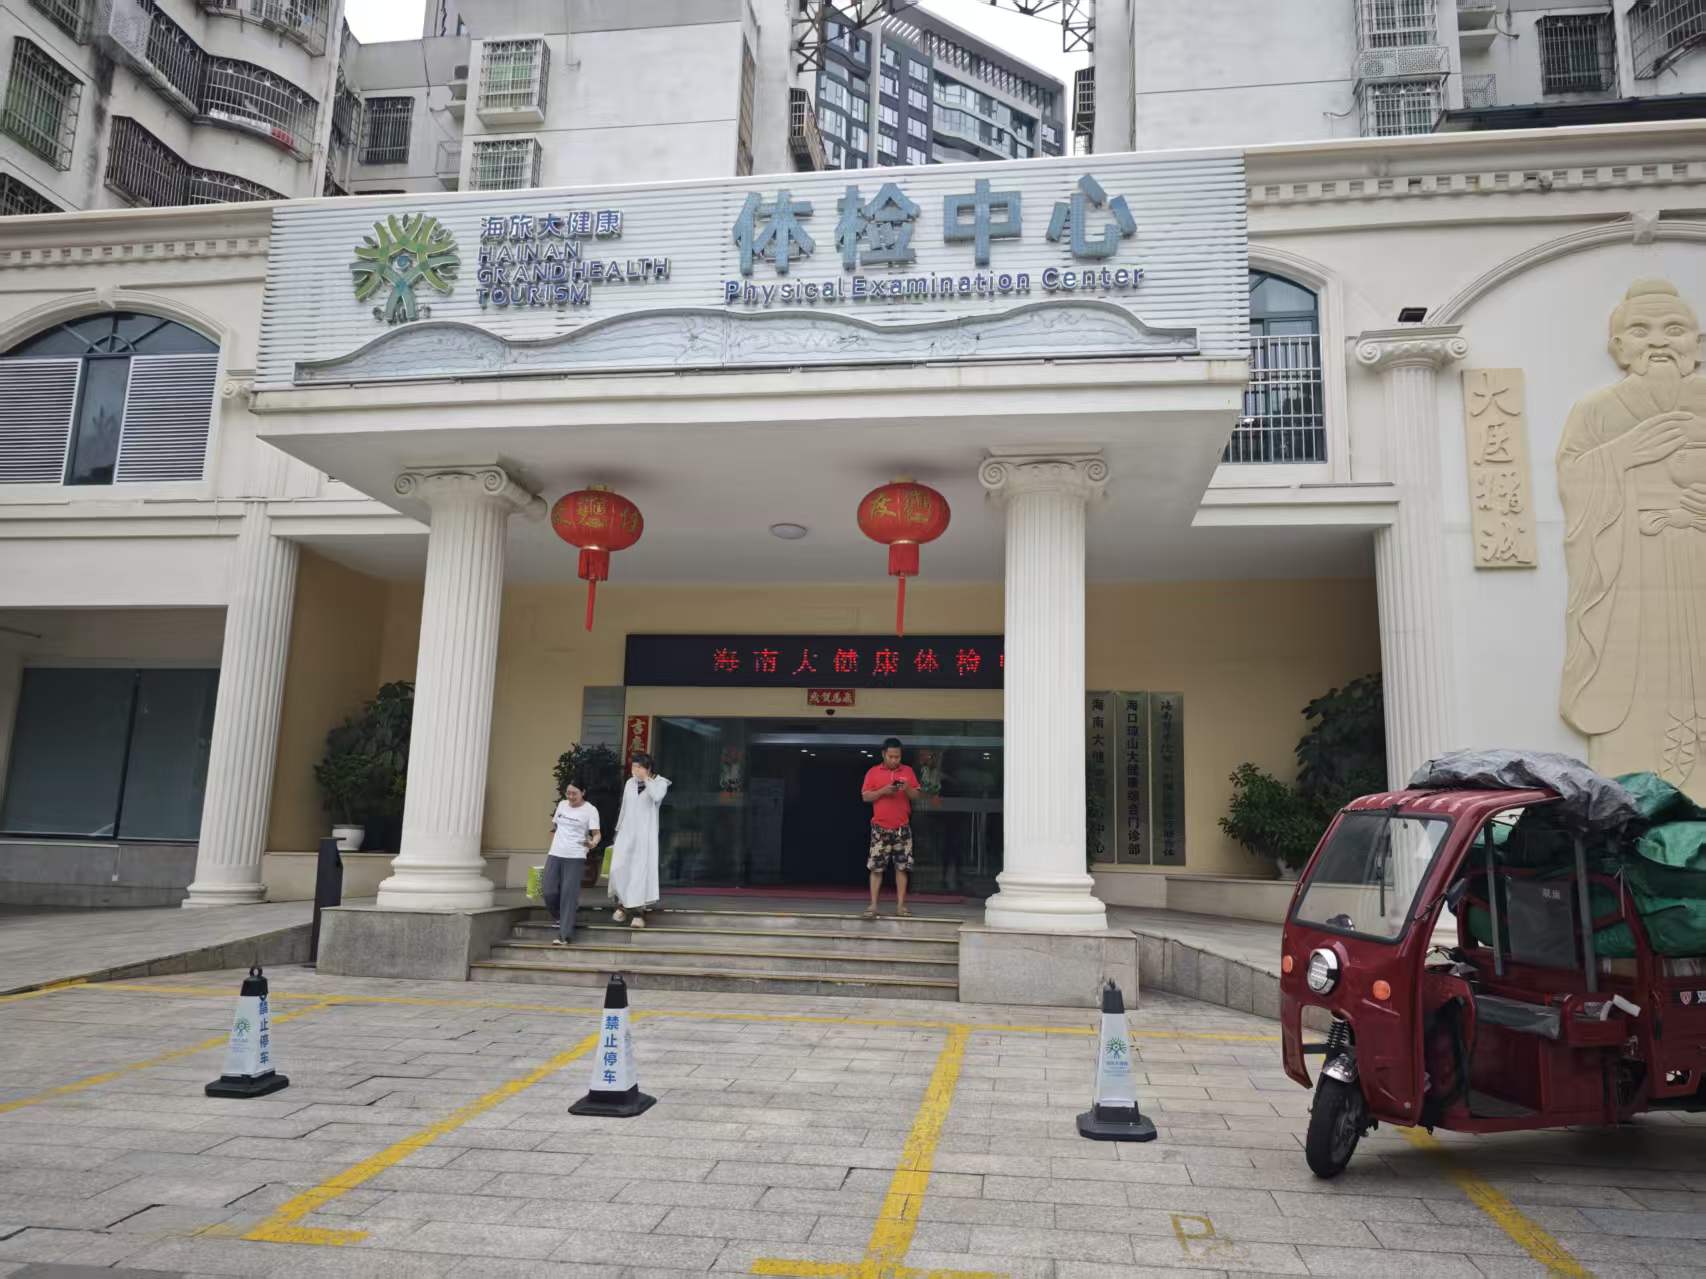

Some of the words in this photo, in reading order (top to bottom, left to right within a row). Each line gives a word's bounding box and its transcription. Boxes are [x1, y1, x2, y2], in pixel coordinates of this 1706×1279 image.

[480, 209, 622, 243] 海旅大健康
[732, 173, 1138, 276] 体检中心
[478, 241, 582, 265] HAINAN
[476, 282, 592, 309] TOURISM
[725, 277, 846, 307] Physical
[851, 271, 1032, 298] Examination
[1042, 265, 1145, 291] Center
[712, 647, 1004, 676] 海南大健康体检
[603, 1015, 619, 1084] 禁止停车
